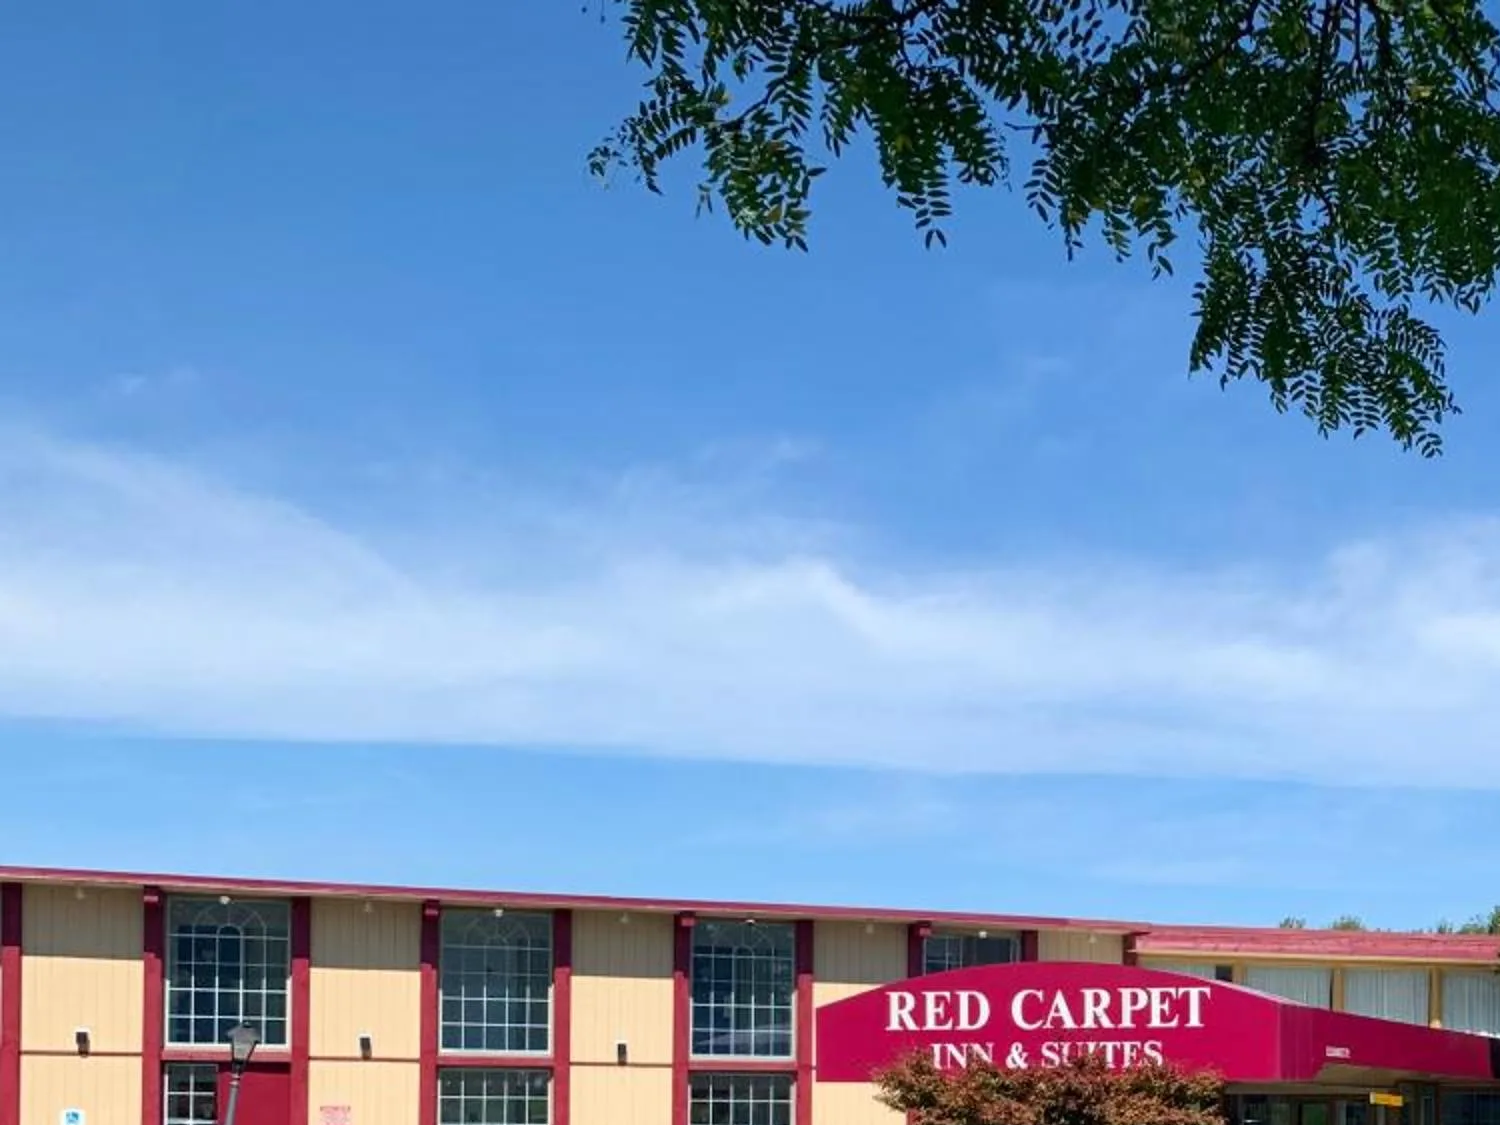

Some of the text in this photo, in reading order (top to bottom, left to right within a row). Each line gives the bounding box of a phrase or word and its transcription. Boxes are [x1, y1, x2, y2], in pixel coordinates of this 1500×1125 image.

[886, 987, 1211, 1031] RED CARPET
[931, 1043, 994, 1069] INN
[1006, 1042, 1028, 1069] &
